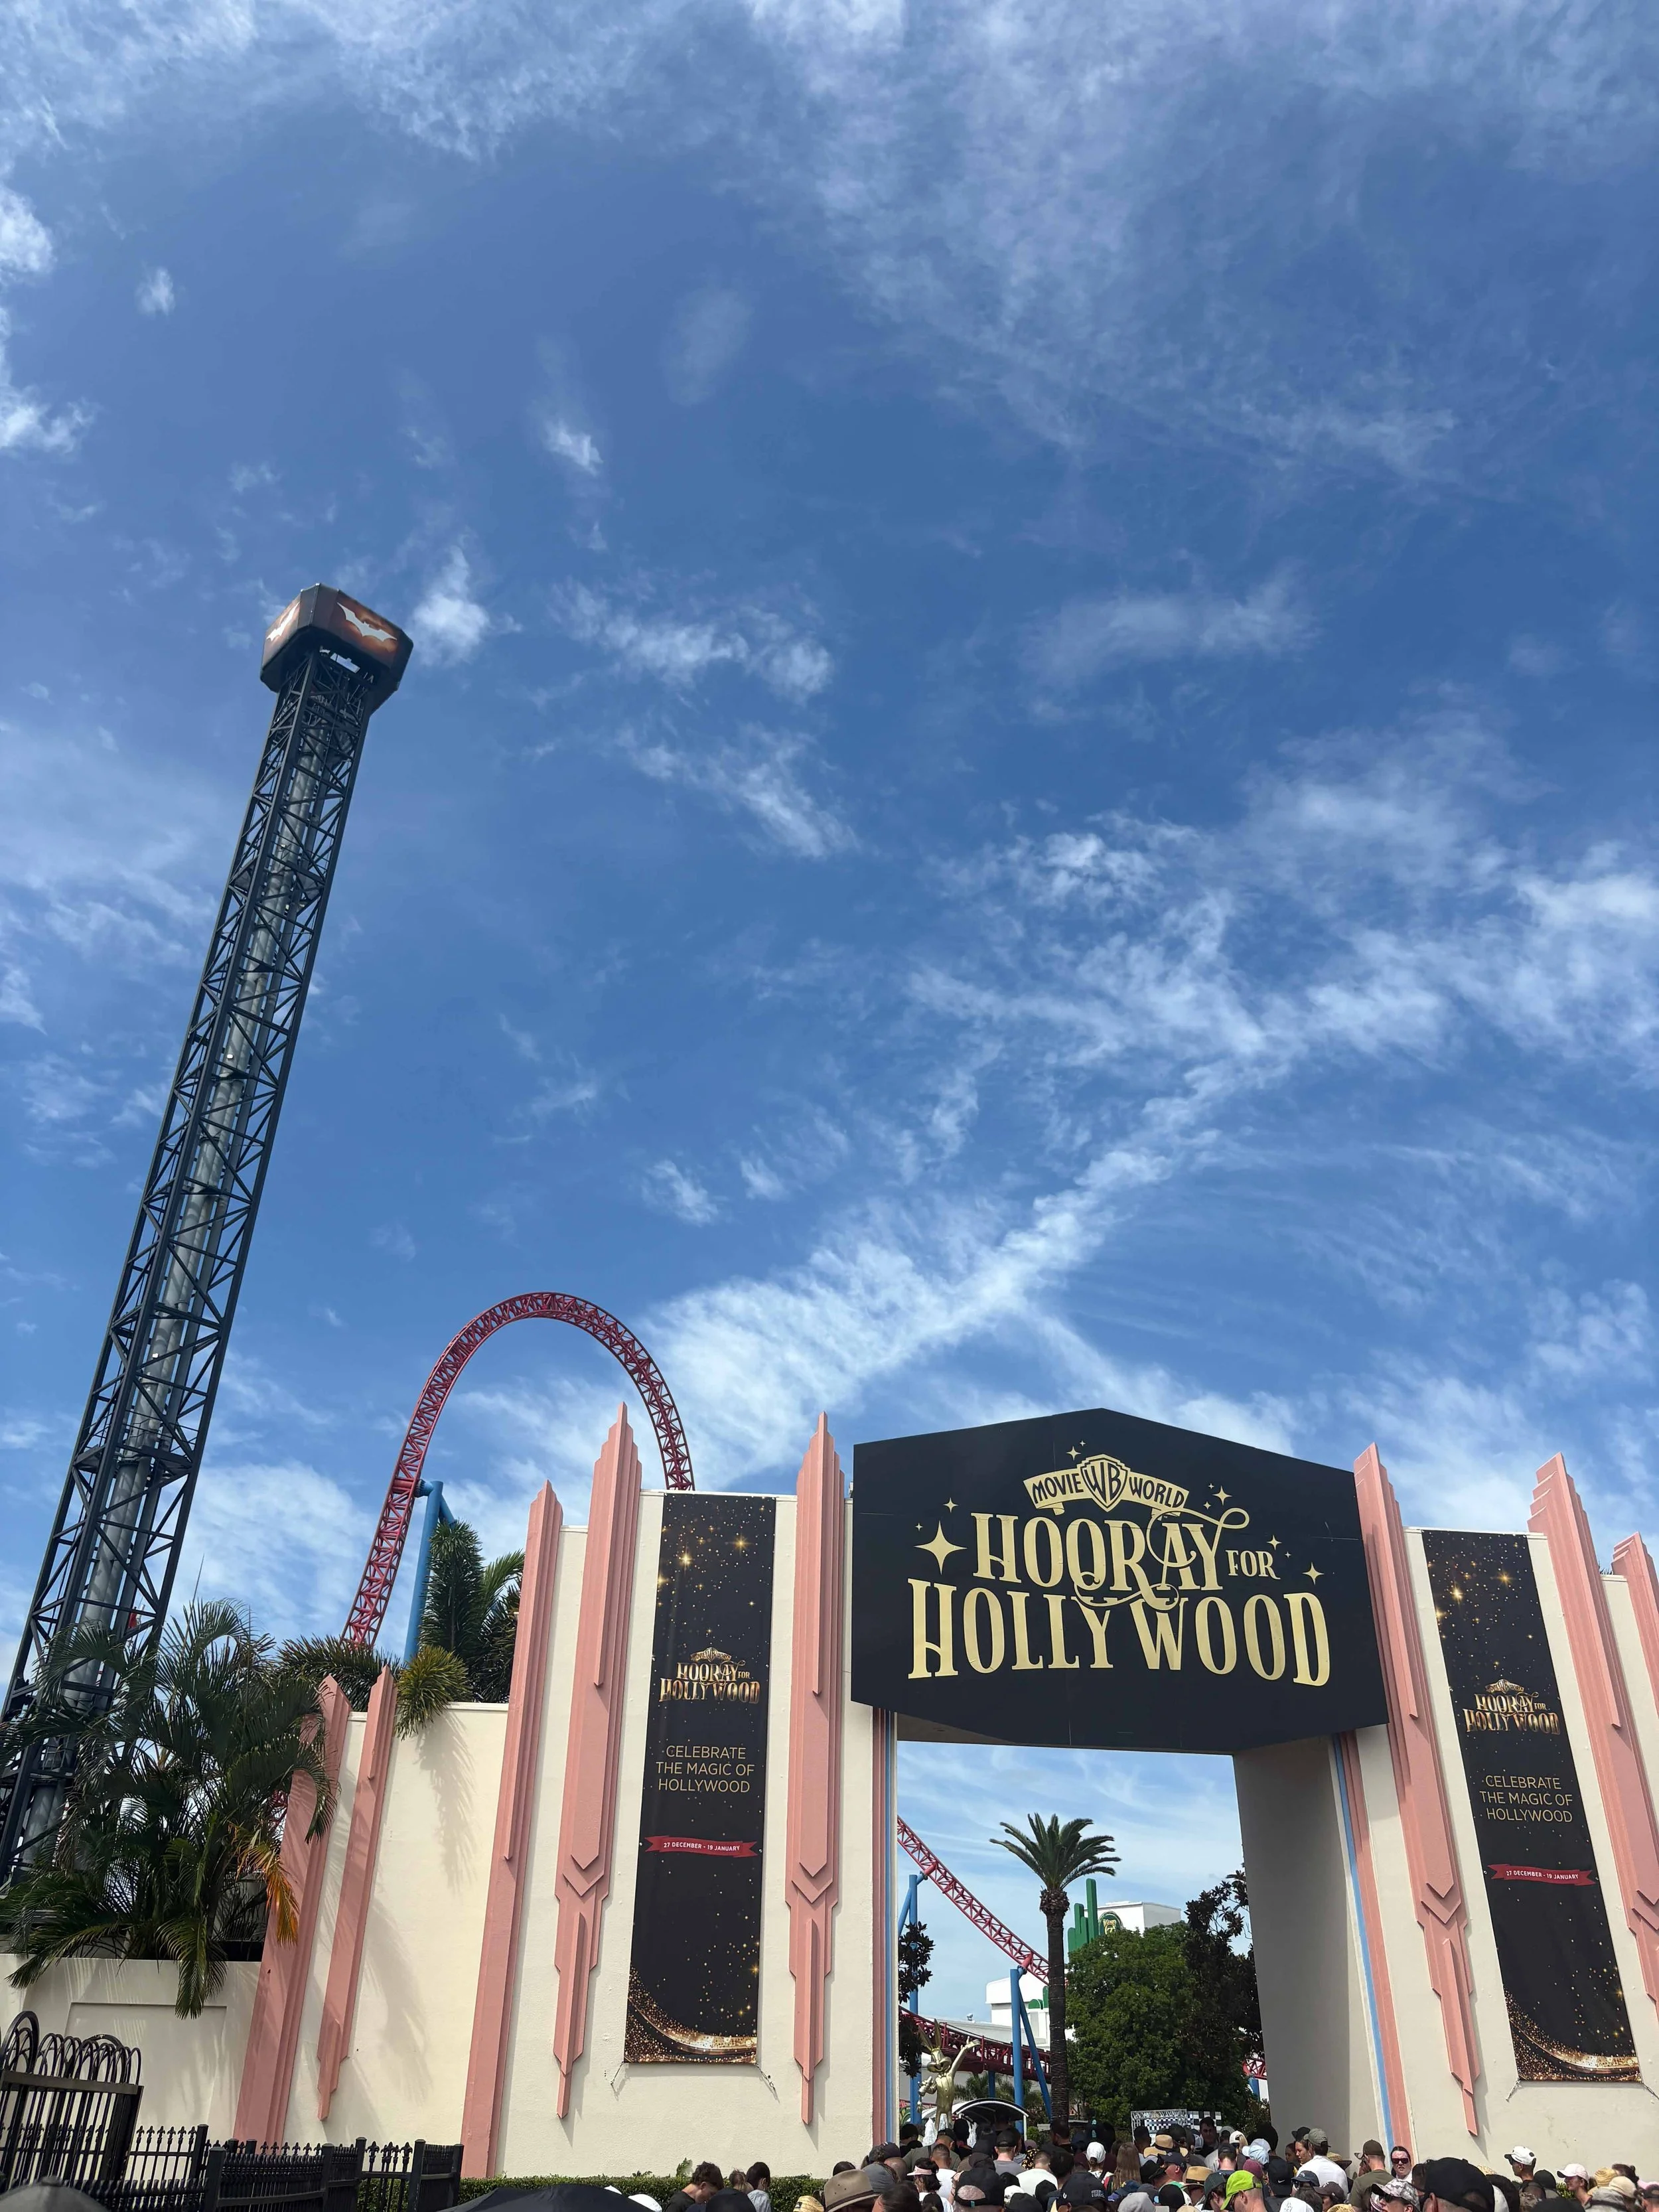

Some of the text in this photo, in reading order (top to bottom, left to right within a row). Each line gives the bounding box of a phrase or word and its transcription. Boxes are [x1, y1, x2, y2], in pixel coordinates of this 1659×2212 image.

[1032, 1461, 1185, 1509] MOVIE WB WORLD
[971, 1508, 1281, 1610] HOORAY FOR
[907, 1578, 1331, 1687] HOLLYWOOD
[676, 1660, 746, 1686] HOORAY
[658, 1678, 760, 1704] HOLLYWOOD
[1474, 1692, 1539, 1718] HOORAY
[1462, 1708, 1560, 1735] HOLLYWOOD
[666, 1745, 747, 1759] CELEBRATE
[656, 1761, 755, 1776] THE MAGIC OF
[658, 1778, 750, 1793] HOLLYWOOD
[1485, 1775, 1561, 1790] CELEBRATE
[1479, 1791, 1573, 1806] THE MAGIC OF
[1486, 1807, 1573, 1822] HOLLYWOOD
